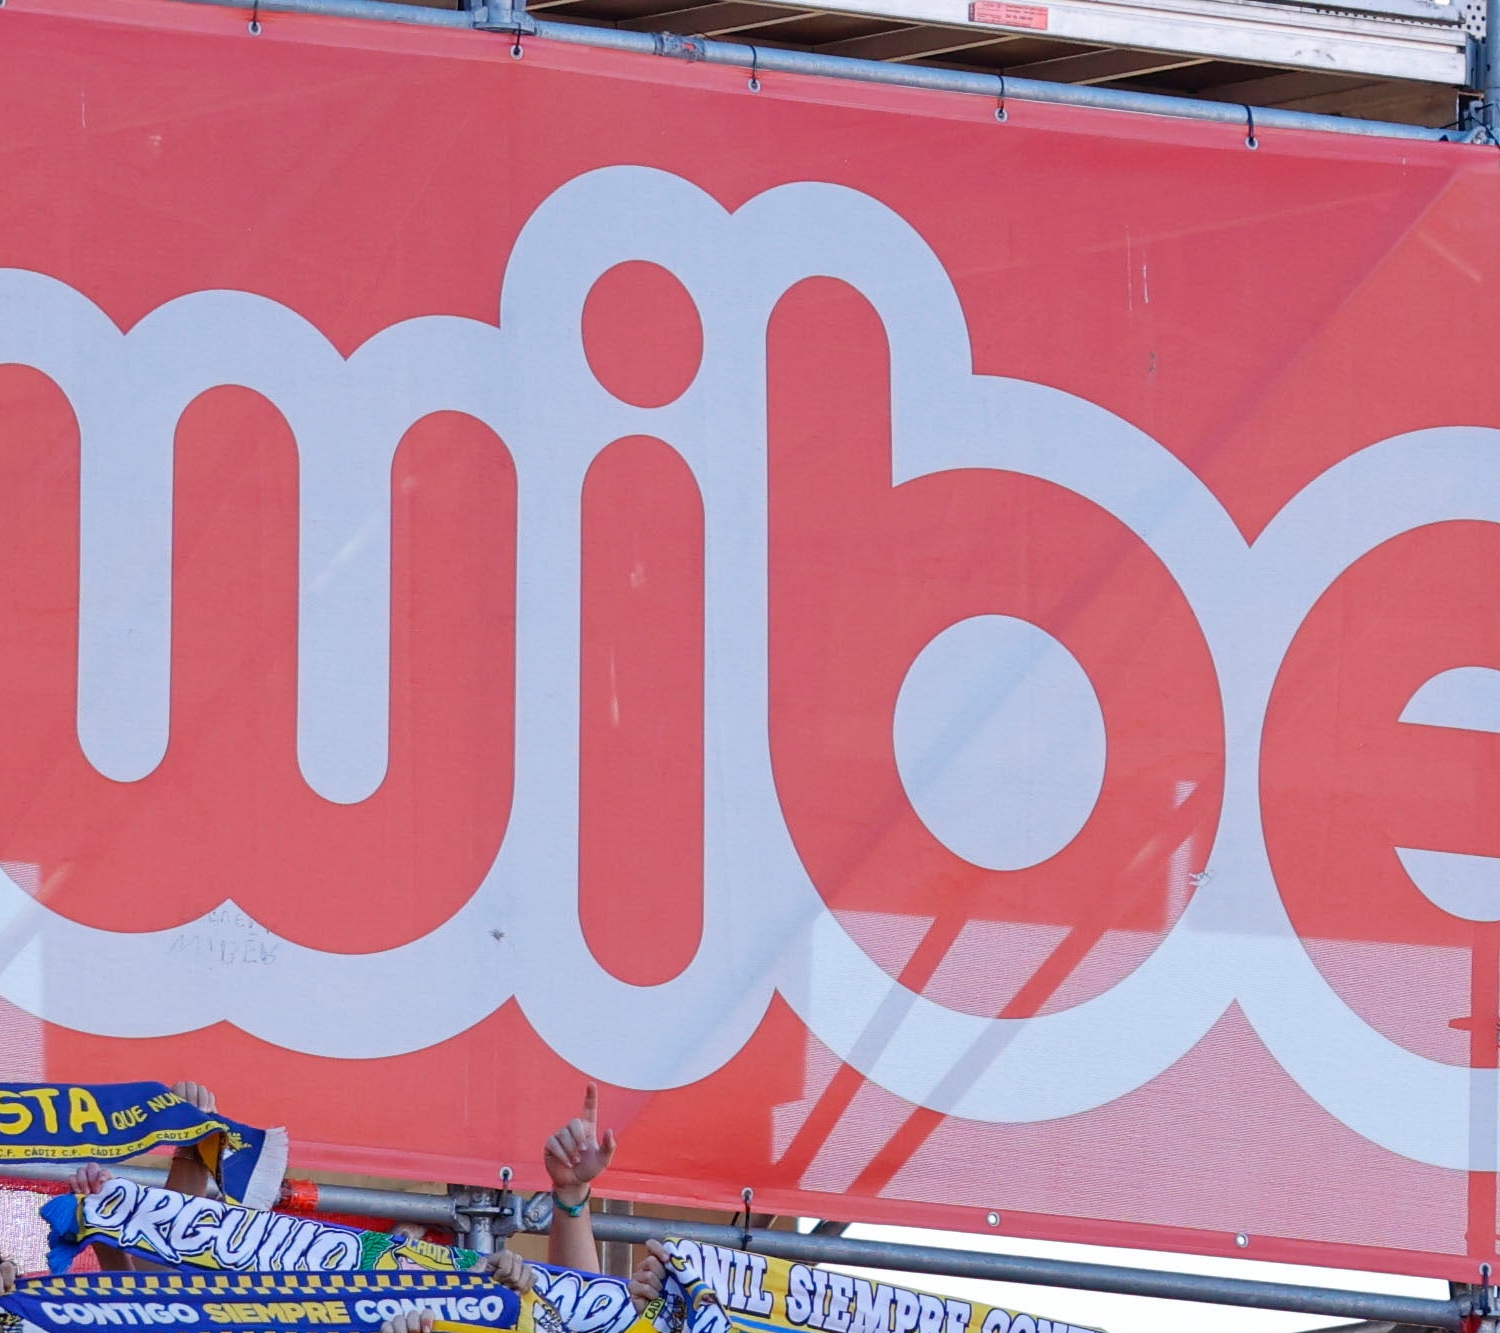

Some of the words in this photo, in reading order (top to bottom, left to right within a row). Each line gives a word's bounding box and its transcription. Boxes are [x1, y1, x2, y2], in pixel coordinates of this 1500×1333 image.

[111, 1104, 147, 1131] QUE
[41, 1301, 200, 1326] CONTIGO
[208, 1299, 350, 1325] SIEMPRE
